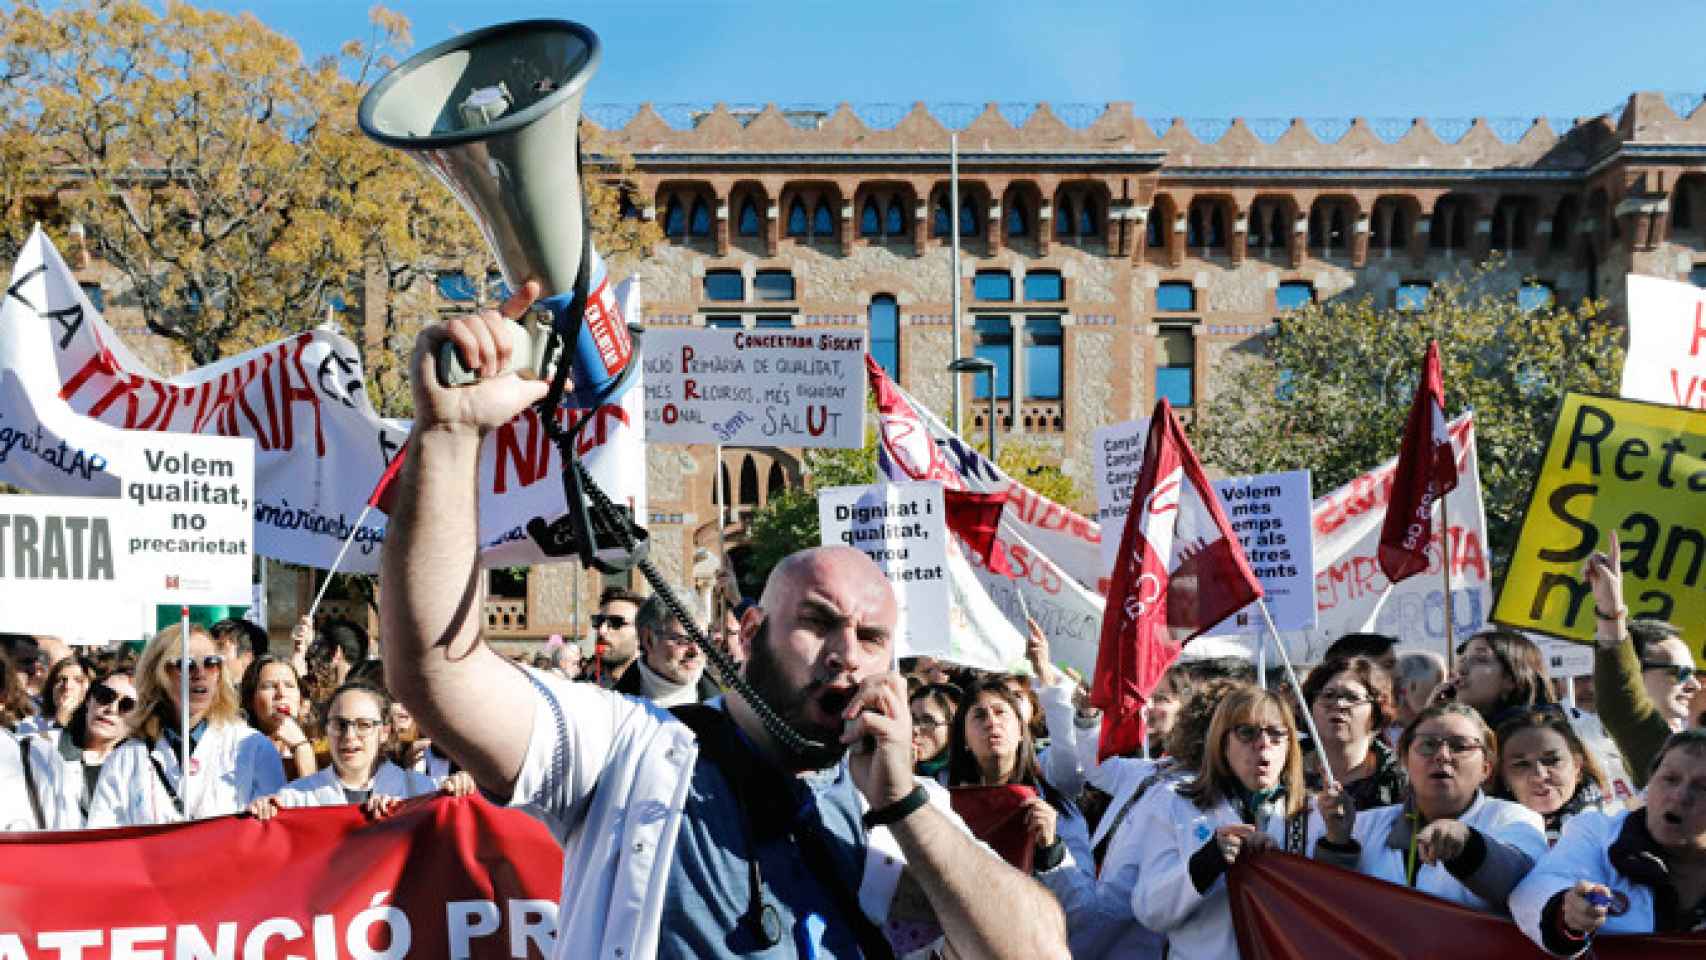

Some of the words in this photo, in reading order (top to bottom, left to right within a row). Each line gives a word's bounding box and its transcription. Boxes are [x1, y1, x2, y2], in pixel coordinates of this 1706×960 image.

[753, 358, 770, 374] DE
[143, 448, 234, 477] Volem
[128, 479, 248, 512] qualitat,
[1222, 486, 1281, 501] Volem
[836, 501, 918, 525] Dignitat
[926, 499, 932, 514] i
[1232, 504, 1271, 516] més
[171, 512, 207, 531] no
[841, 523, 928, 546] qualitat,
[1257, 532, 1286, 545] als
[128, 536, 248, 556] precarietat
